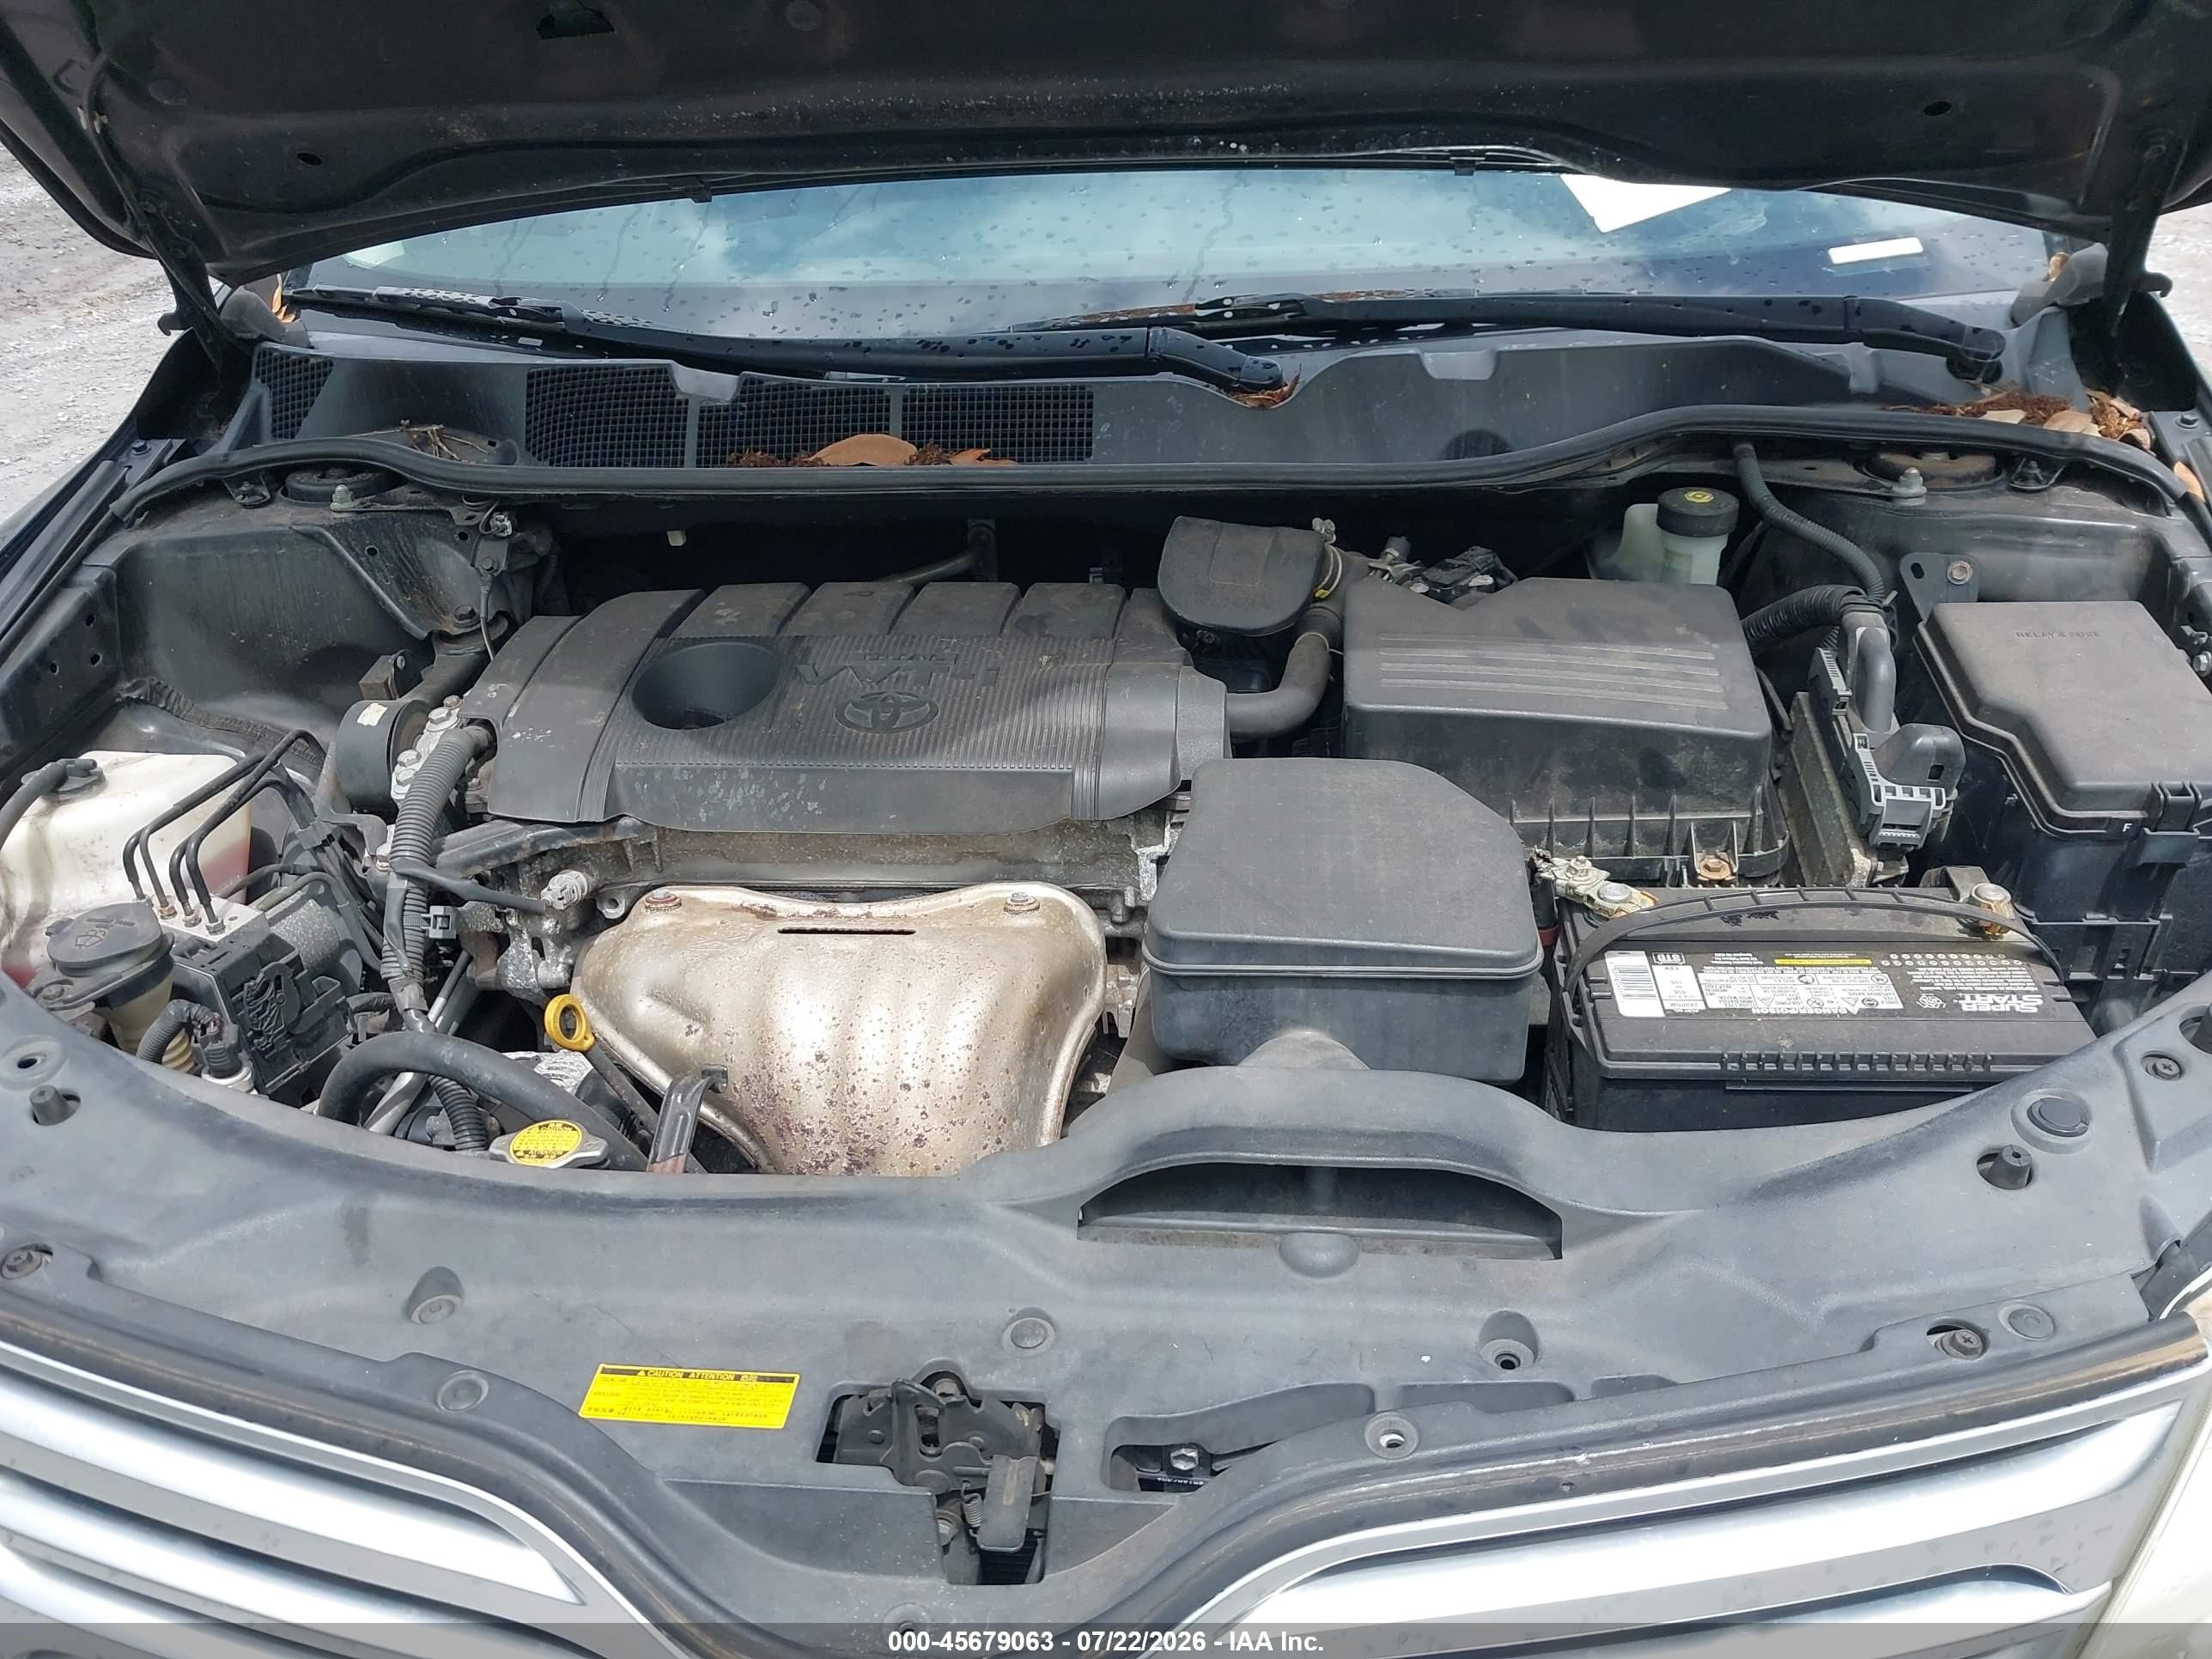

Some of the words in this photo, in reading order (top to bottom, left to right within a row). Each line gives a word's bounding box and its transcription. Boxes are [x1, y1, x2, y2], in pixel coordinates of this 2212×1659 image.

[2013, 630, 2055, 639] RELAY
[1958, 994, 2044, 1005] START
[1961, 1003, 2039, 1012] SUPER
[647, 1370, 683, 1378] CAUTION
[689, 1371, 735, 1381] ATTENTION
